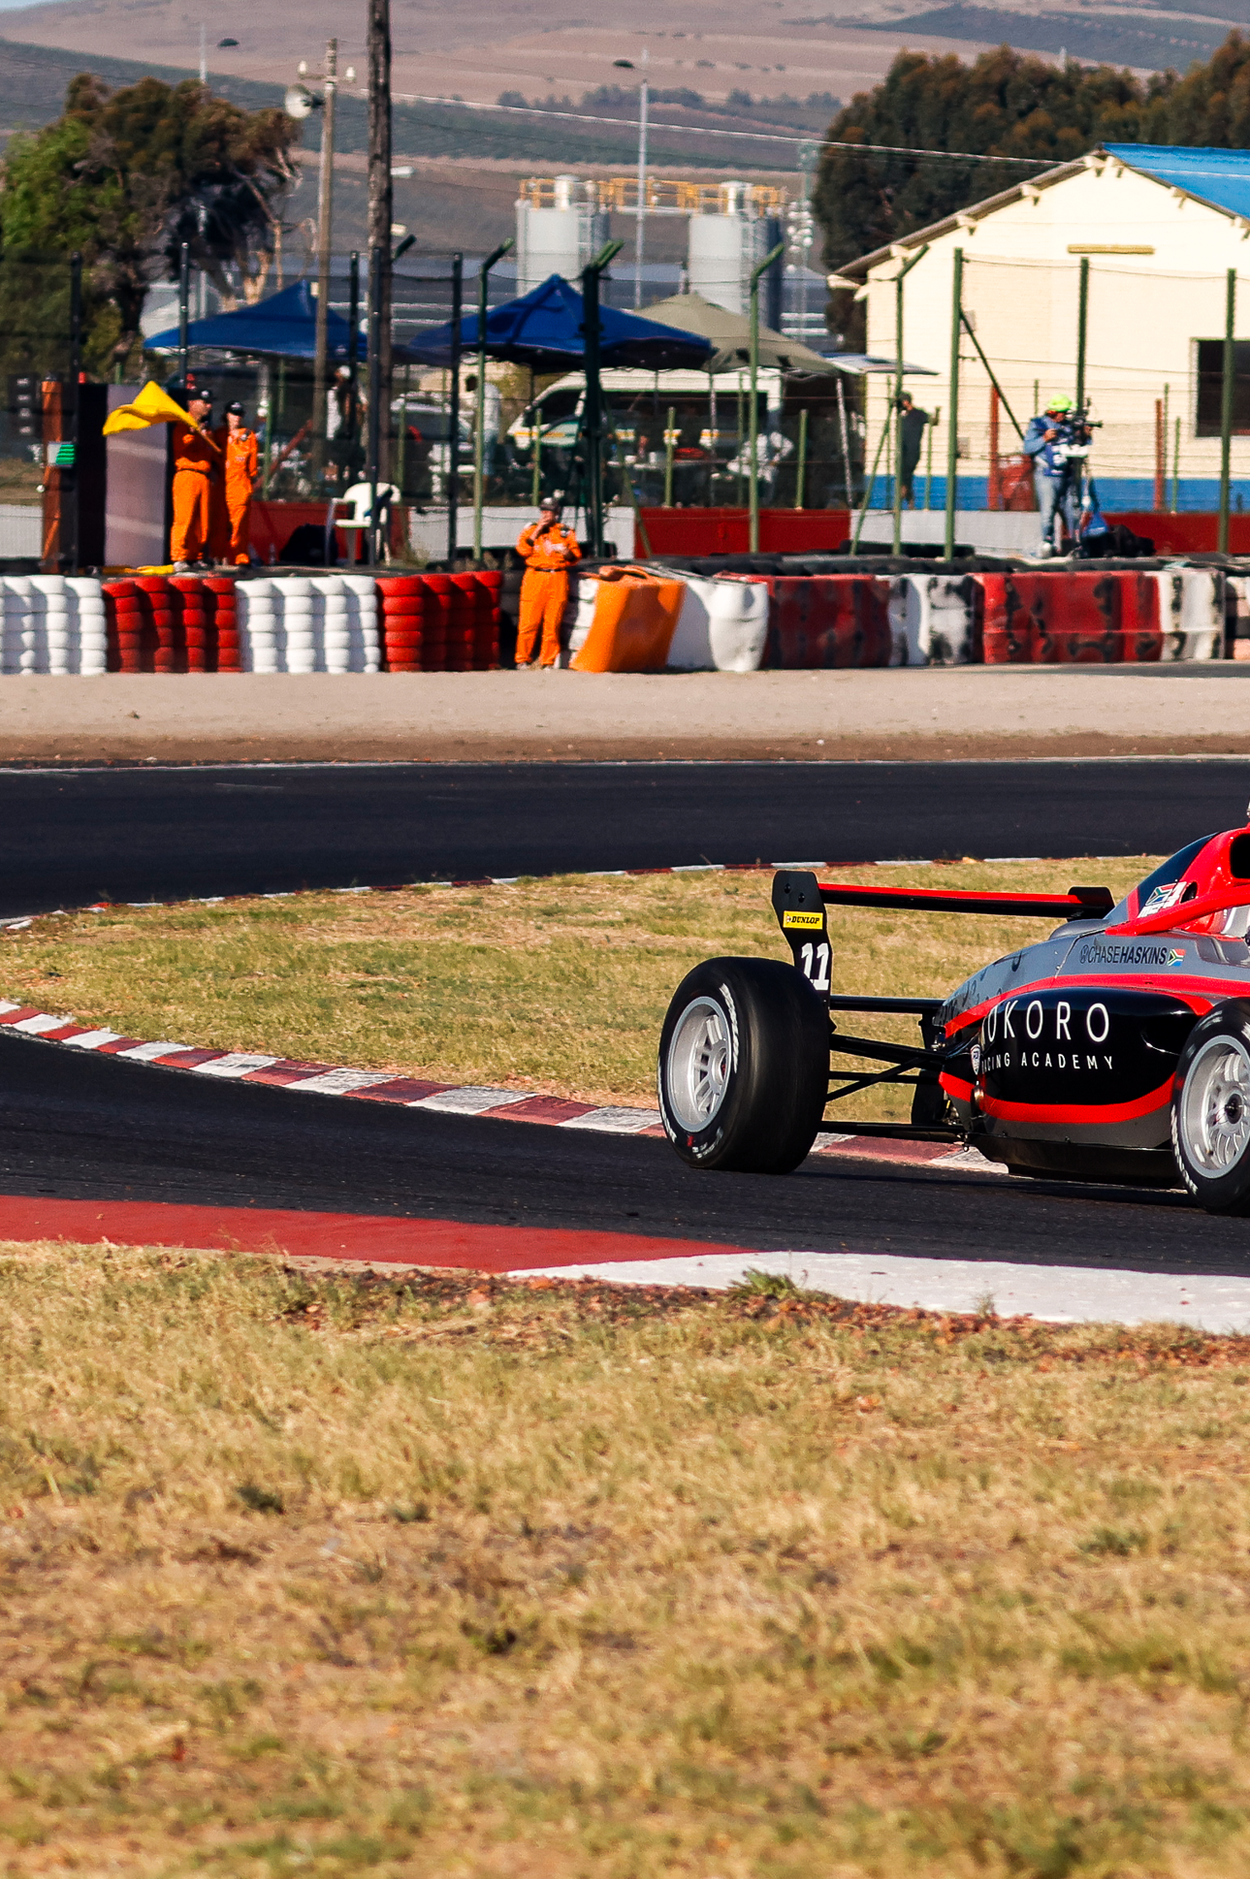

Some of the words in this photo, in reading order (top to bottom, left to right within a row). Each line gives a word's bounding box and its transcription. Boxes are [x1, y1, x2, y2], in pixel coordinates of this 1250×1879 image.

[791, 916, 820, 925] DUNLOP
[801, 943, 830, 990] 11
[1021, 1052, 1113, 1070] ACADEMY
